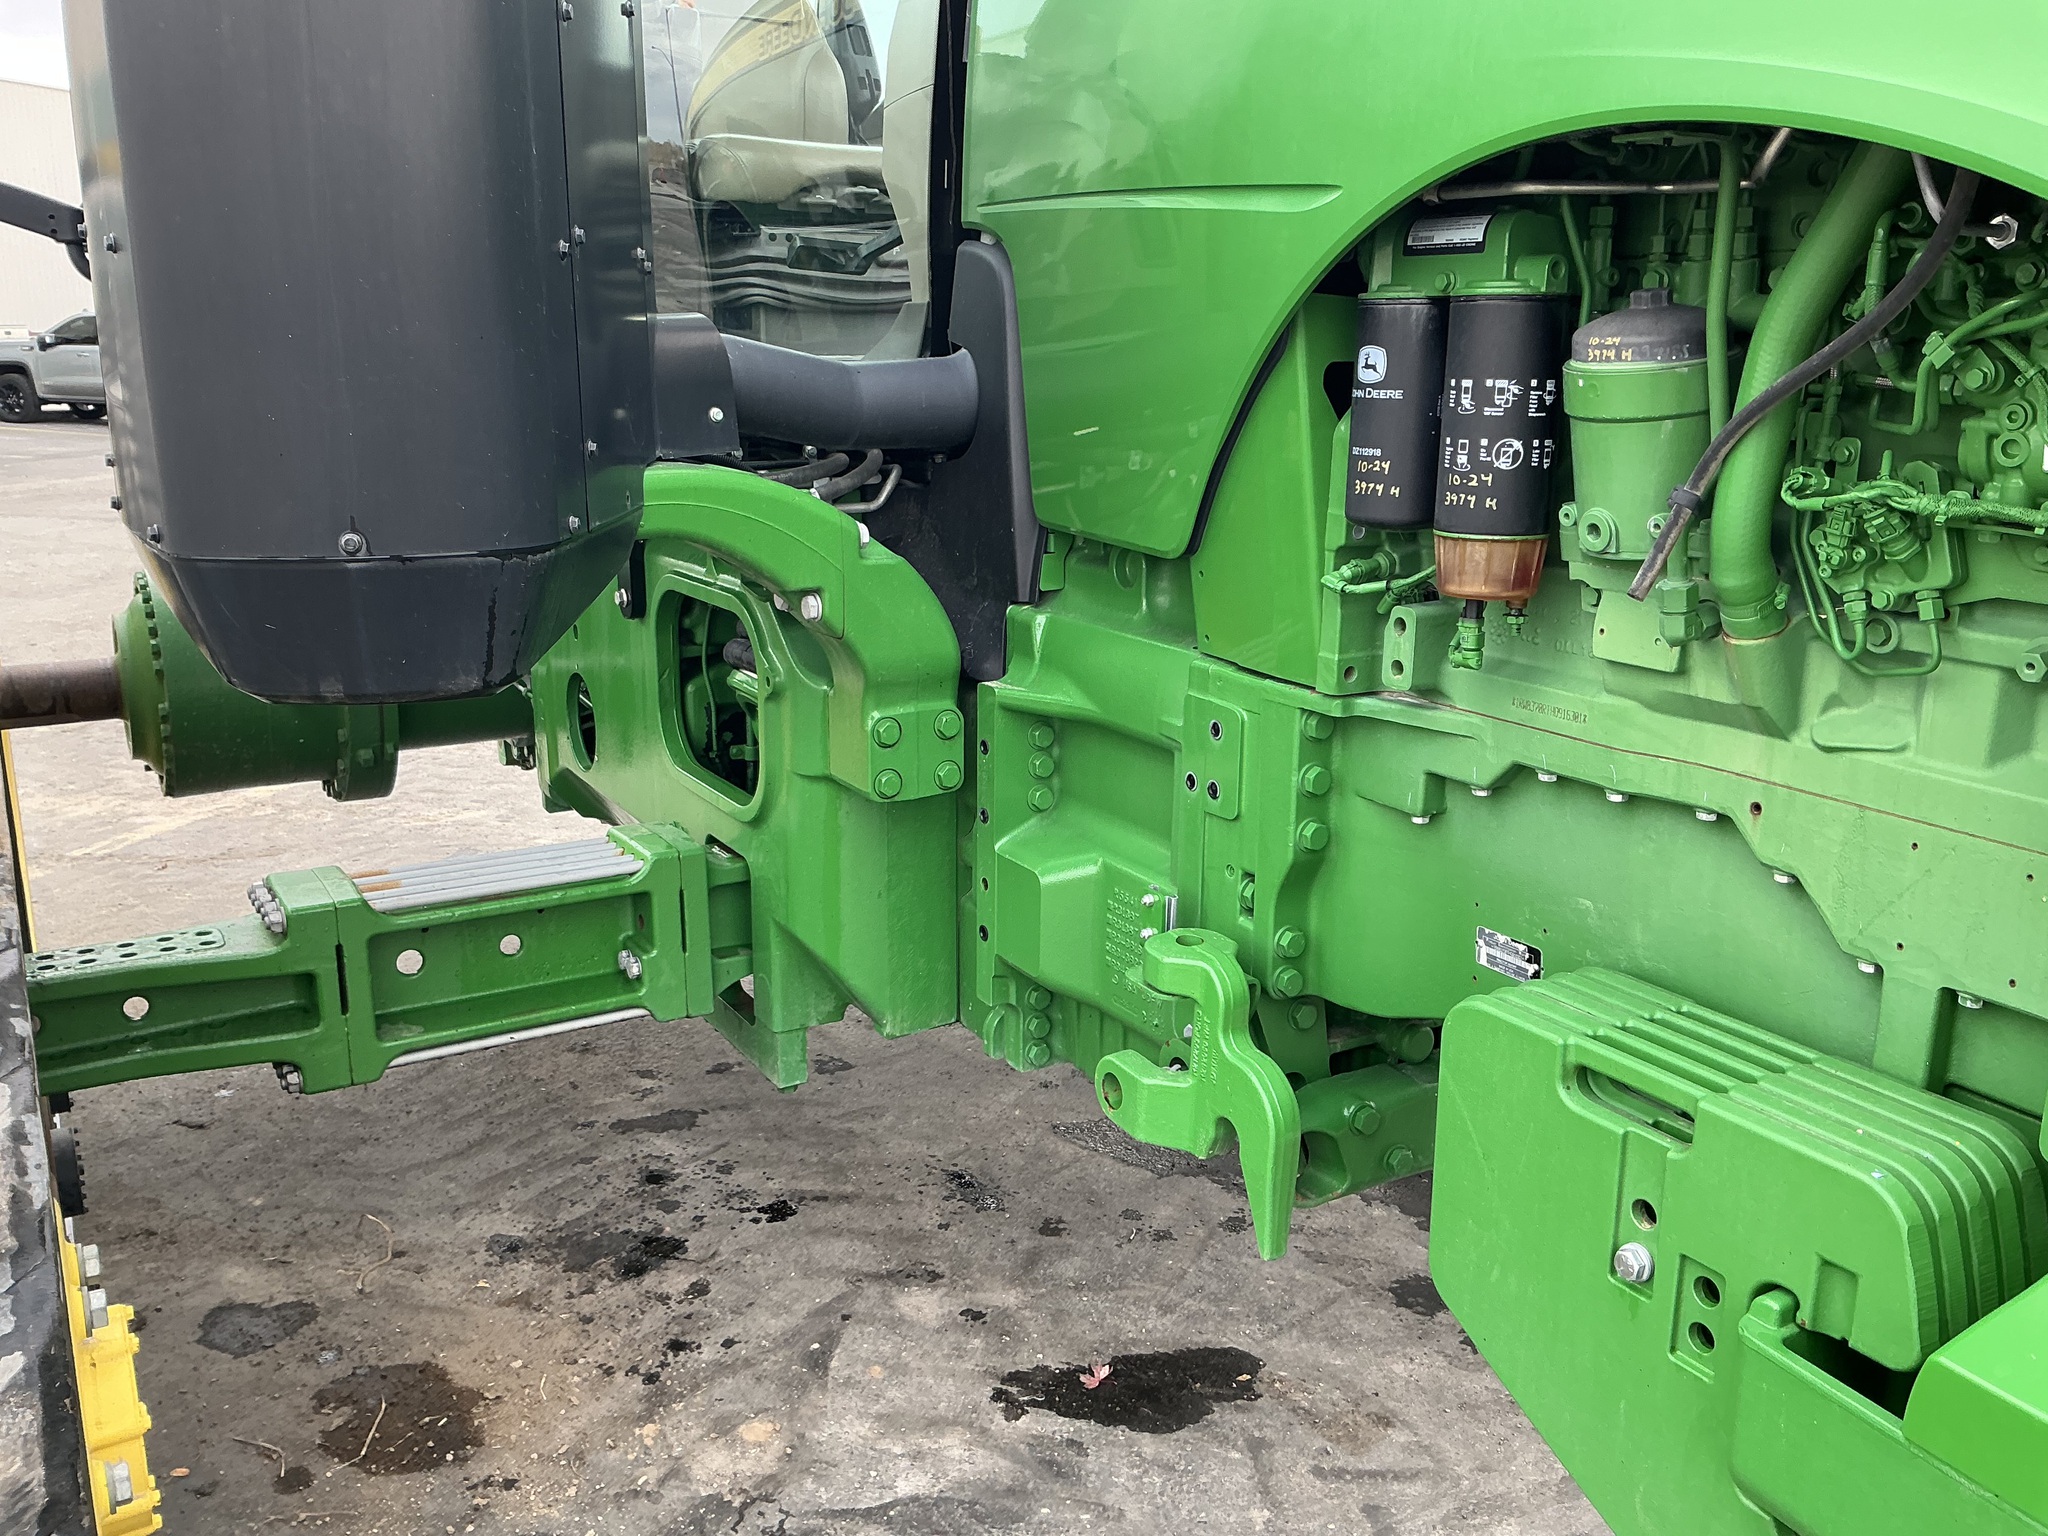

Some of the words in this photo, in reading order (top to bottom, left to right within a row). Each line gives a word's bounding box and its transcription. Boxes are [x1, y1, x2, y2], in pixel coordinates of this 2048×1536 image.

[1588, 337, 1621, 346] 10-24
[1588, 348, 1615, 361] 3974
[1621, 348, 1632, 361] H
[1352, 389, 1365, 398] OHN
[1365, 387, 1404, 399] DEERE
[1352, 446, 1382, 456] DZ112918
[1357, 460, 1391, 475] 10-24
[1448, 473, 1493, 487] 10-24
[1354, 479, 1384, 497] 3974
[1389, 486, 1400, 498] H
[1444, 491, 1476, 509] 3974
[1485, 497, 1497, 511] H
